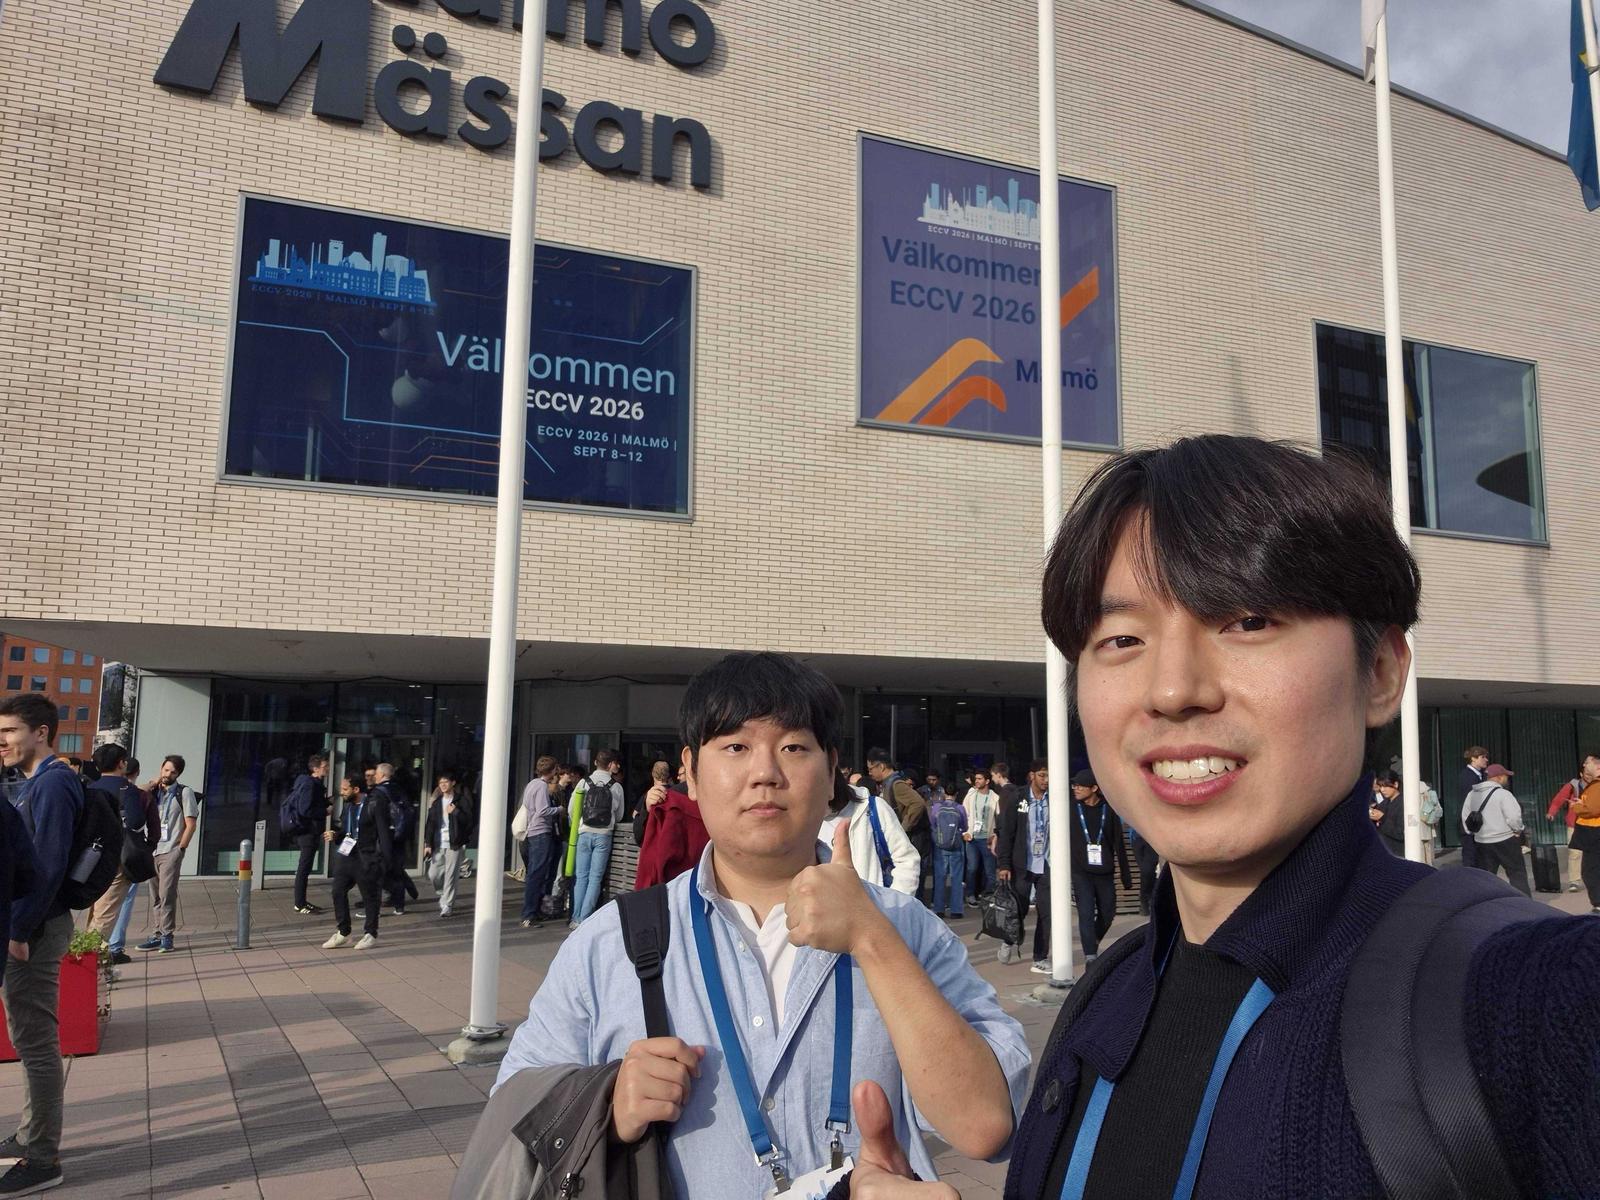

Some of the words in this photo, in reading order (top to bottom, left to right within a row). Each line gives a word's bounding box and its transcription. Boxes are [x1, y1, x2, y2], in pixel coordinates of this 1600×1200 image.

[928, 225, 950, 236] ECCV
[952, 231, 971, 240] 2026
[890, 280, 964, 313] ECCV
[972, 294, 1037, 325] 2026
[436, 331, 675, 396] Välommen
[1016, 358, 1098, 390] Mmö
[590, 396, 645, 420] 2026
[537, 425, 574, 438] ECCV
[578, 429, 609, 442] 2026
[622, 434, 669, 448] MALMÖ
[573, 446, 607, 458] SEPT
